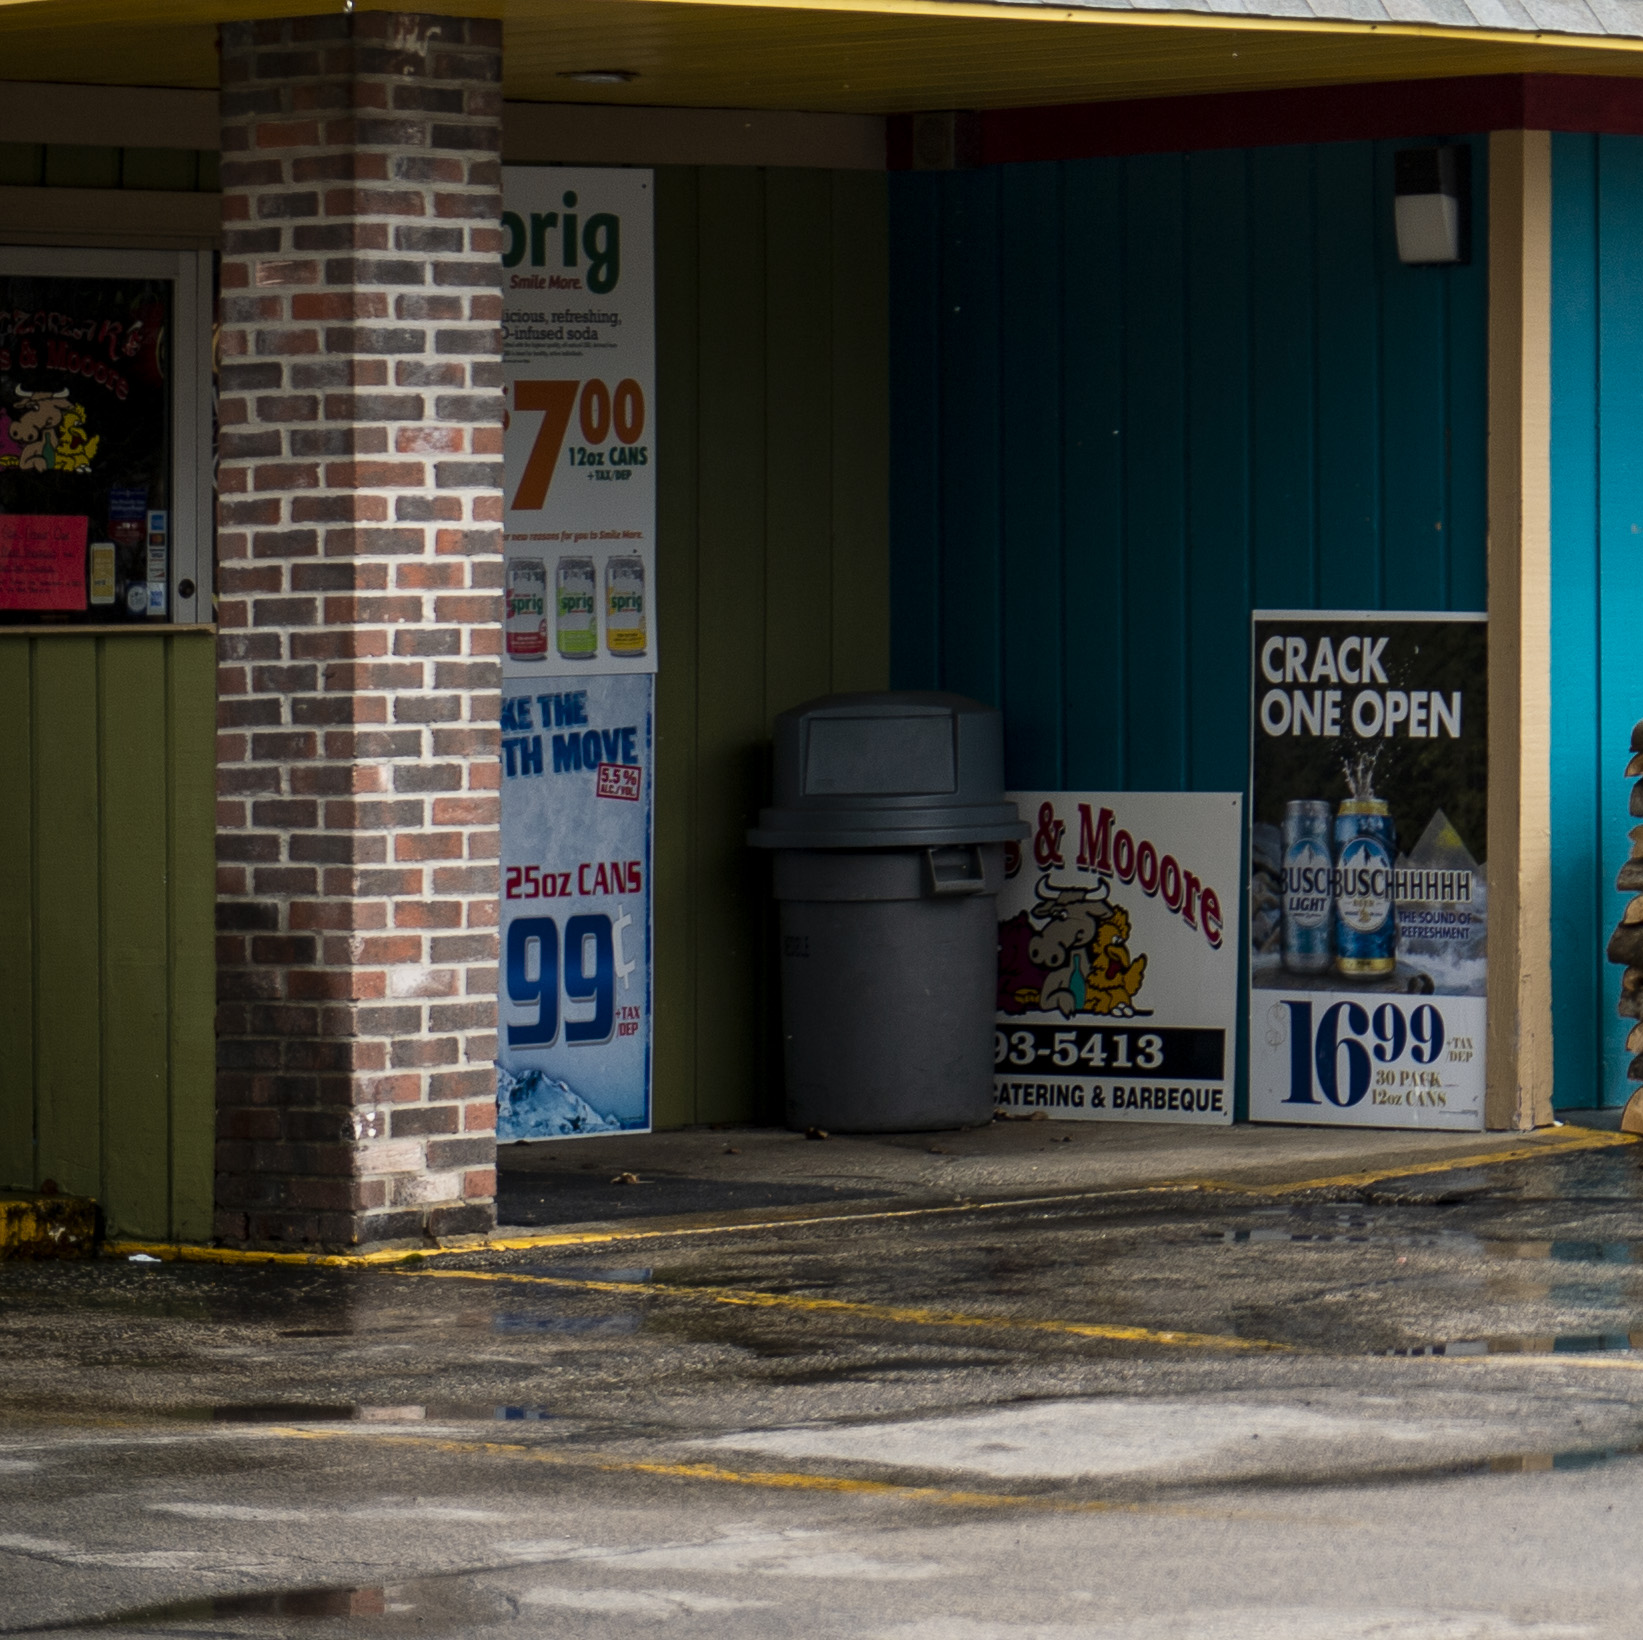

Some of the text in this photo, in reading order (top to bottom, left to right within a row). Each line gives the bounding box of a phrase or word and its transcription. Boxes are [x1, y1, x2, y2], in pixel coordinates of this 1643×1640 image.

[502, 190, 621, 295] prig
[510, 274, 583, 290] Smile More.
[552, 309, 622, 327] refreshing,
[567, 327, 598, 340] soda
[569, 447, 647, 466] 12oz CANS
[511, 592, 544, 615] sprig
[561, 592, 594, 614] sprig
[612, 592, 643, 614] sprig
[1260, 635, 1389, 684] CRACK
[537, 690, 588, 728] THE
[1260, 688, 1461, 738] ONE OPEN
[553, 726, 638, 773] MOVE
[601, 768, 637, 786] 5.5 %
[505, 861, 642, 899] 25oz CANS
[1034, 801, 1223, 948] & Mooore
[1281, 867, 1334, 895] BUSCH
[1289, 899, 1328, 911] LIGHT
[1399, 911, 1472, 923] THE SOUND OF
[1402, 926, 1470, 940] REFRESHMENT
[615, 1006, 640, 1020] +TAX
[619, 1022, 638, 1037] /DEP
[1447, 1036, 1473, 1049] +TAX
[1376, 1071, 1443, 1087] 30 PACK
[1092, 1085, 1106, 1108] &
[1113, 1086, 1223, 1113] BARBEQUE
[1372, 1089, 1447, 1107] 12oz CANS
